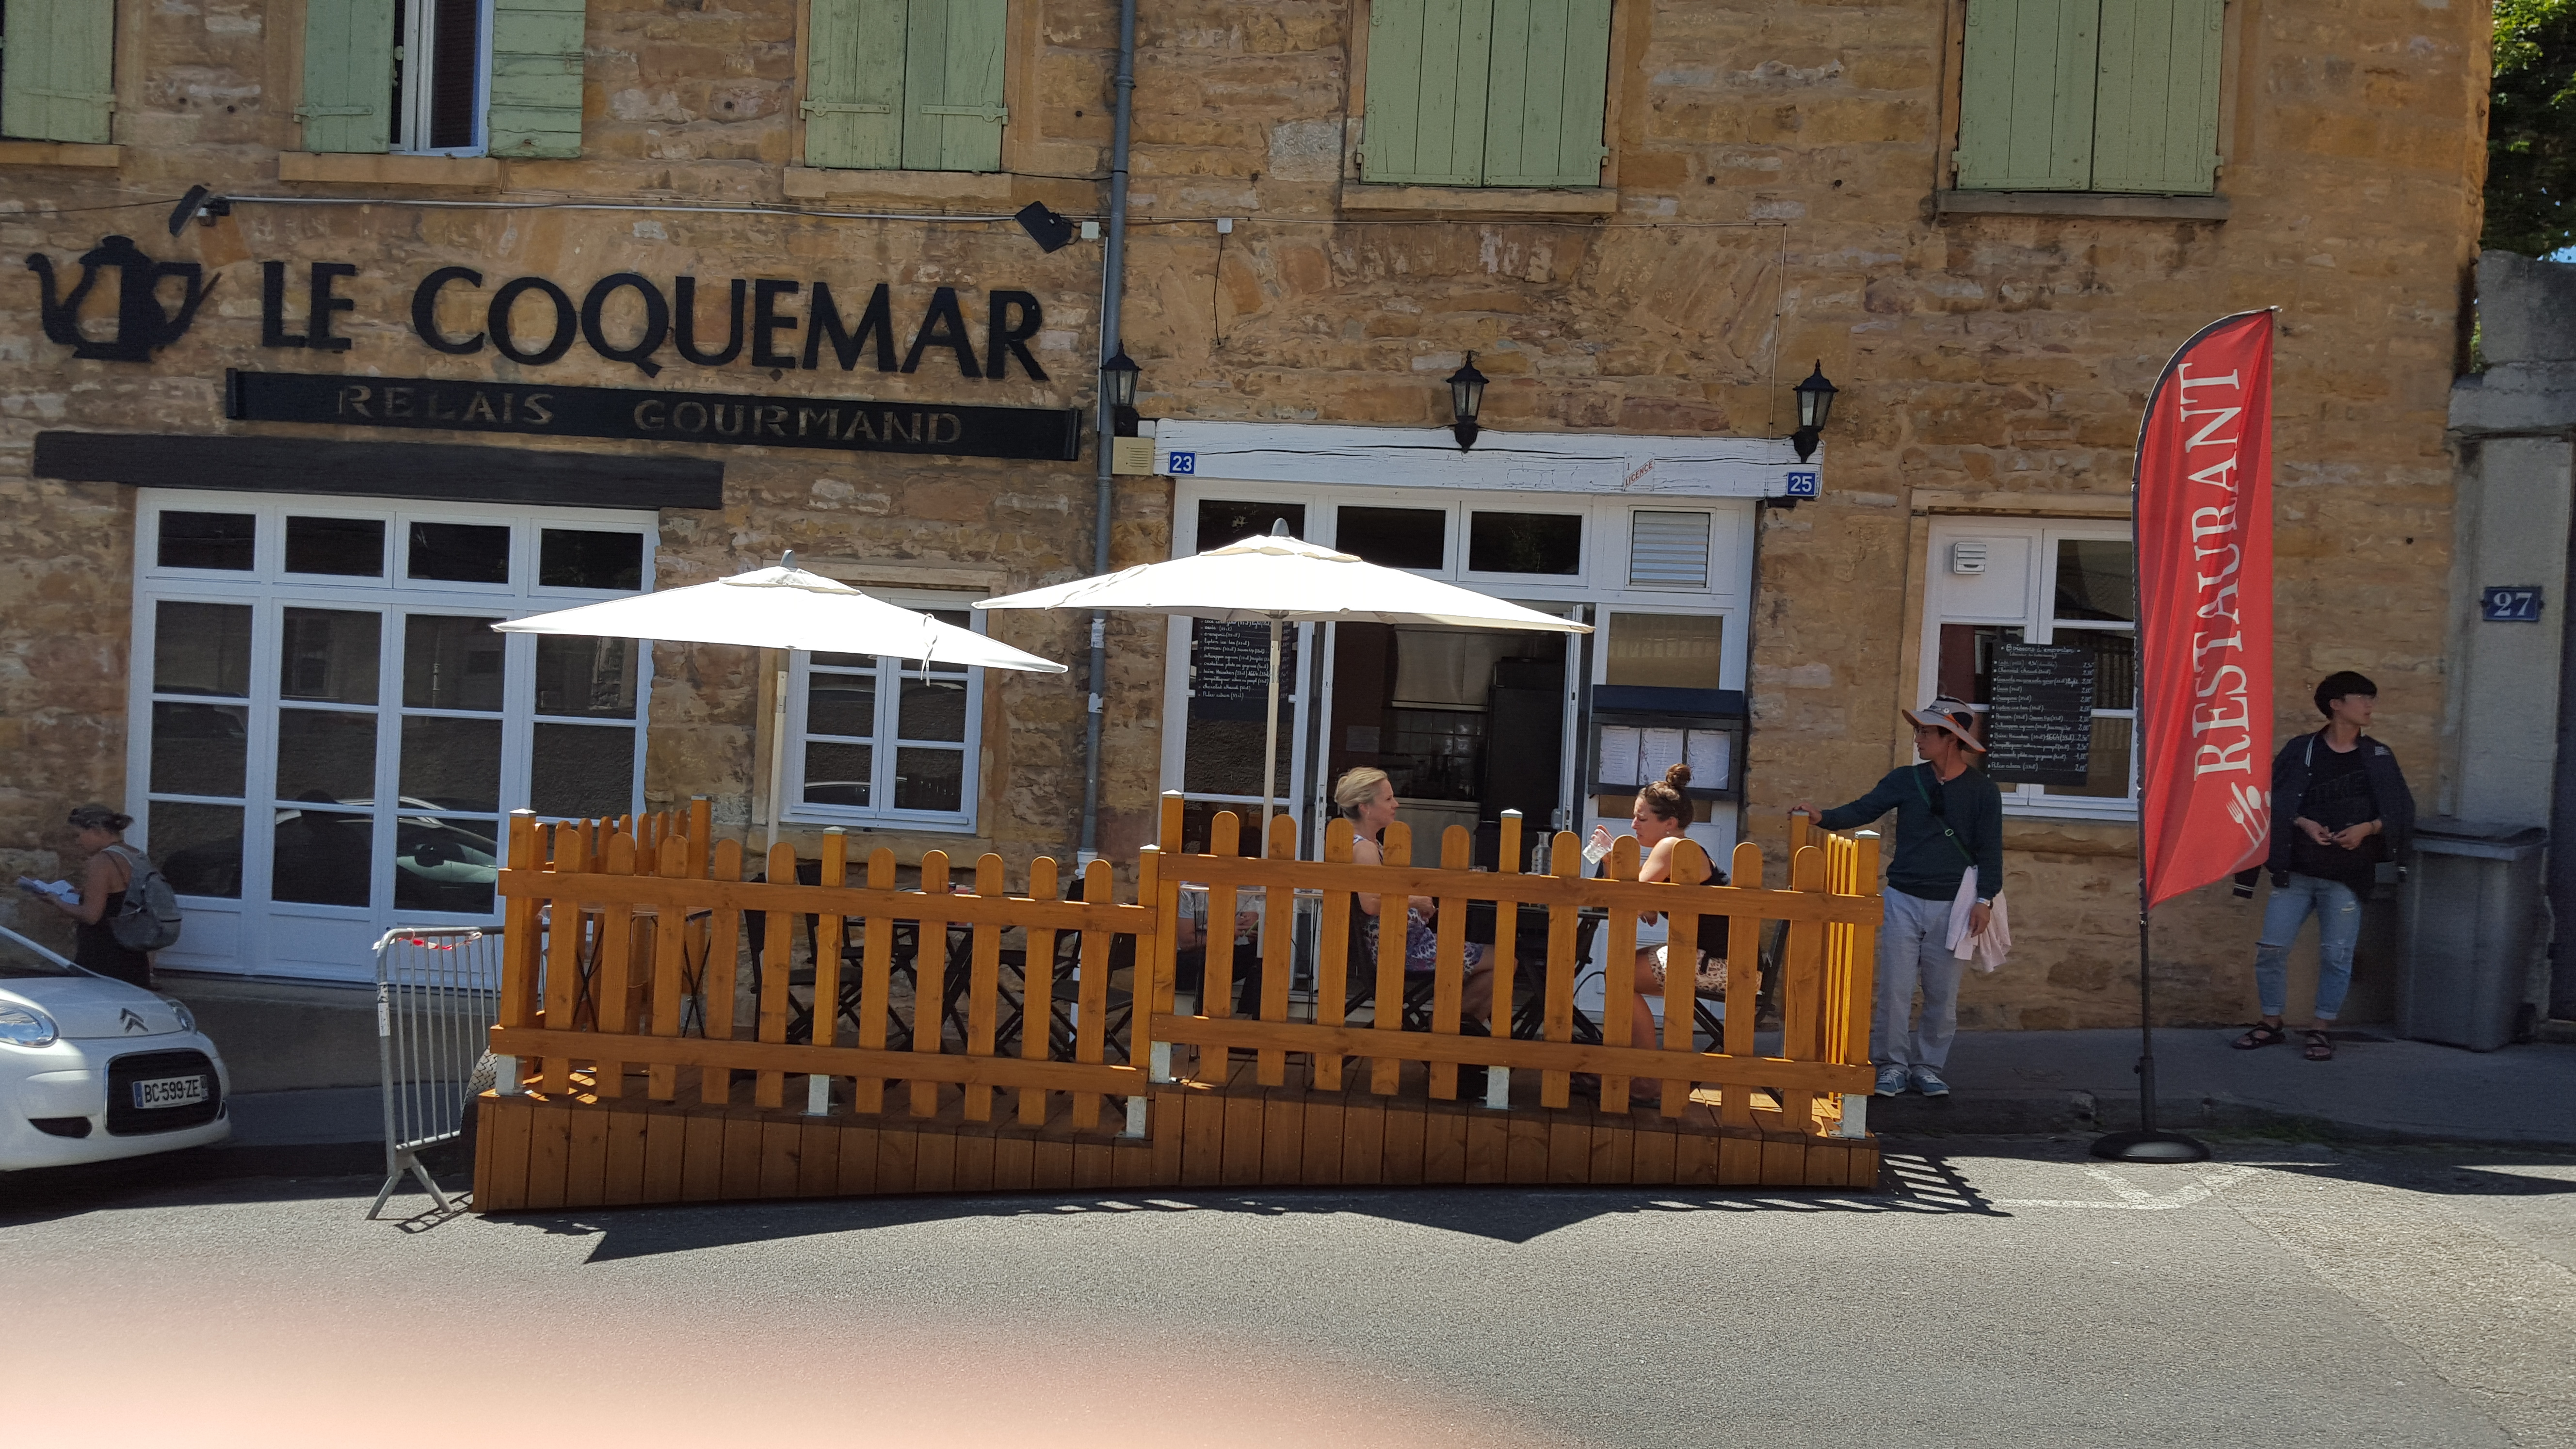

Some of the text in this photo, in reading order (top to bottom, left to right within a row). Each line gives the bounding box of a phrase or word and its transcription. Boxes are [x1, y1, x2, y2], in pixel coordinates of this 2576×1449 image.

[262, 261, 1050, 382] LE COQUEMAR
[338, 384, 963, 445] RELAIS GOURMAND
[1172, 455, 1192, 471] 23
[1626, 459, 1653, 486] LICENCE
[1790, 475, 1813, 492] 25
[2177, 361, 2253, 782] RESTAURANT
[2493, 592, 2533, 616] 27
[145, 1079, 200, 1103] BC-599-ZE
